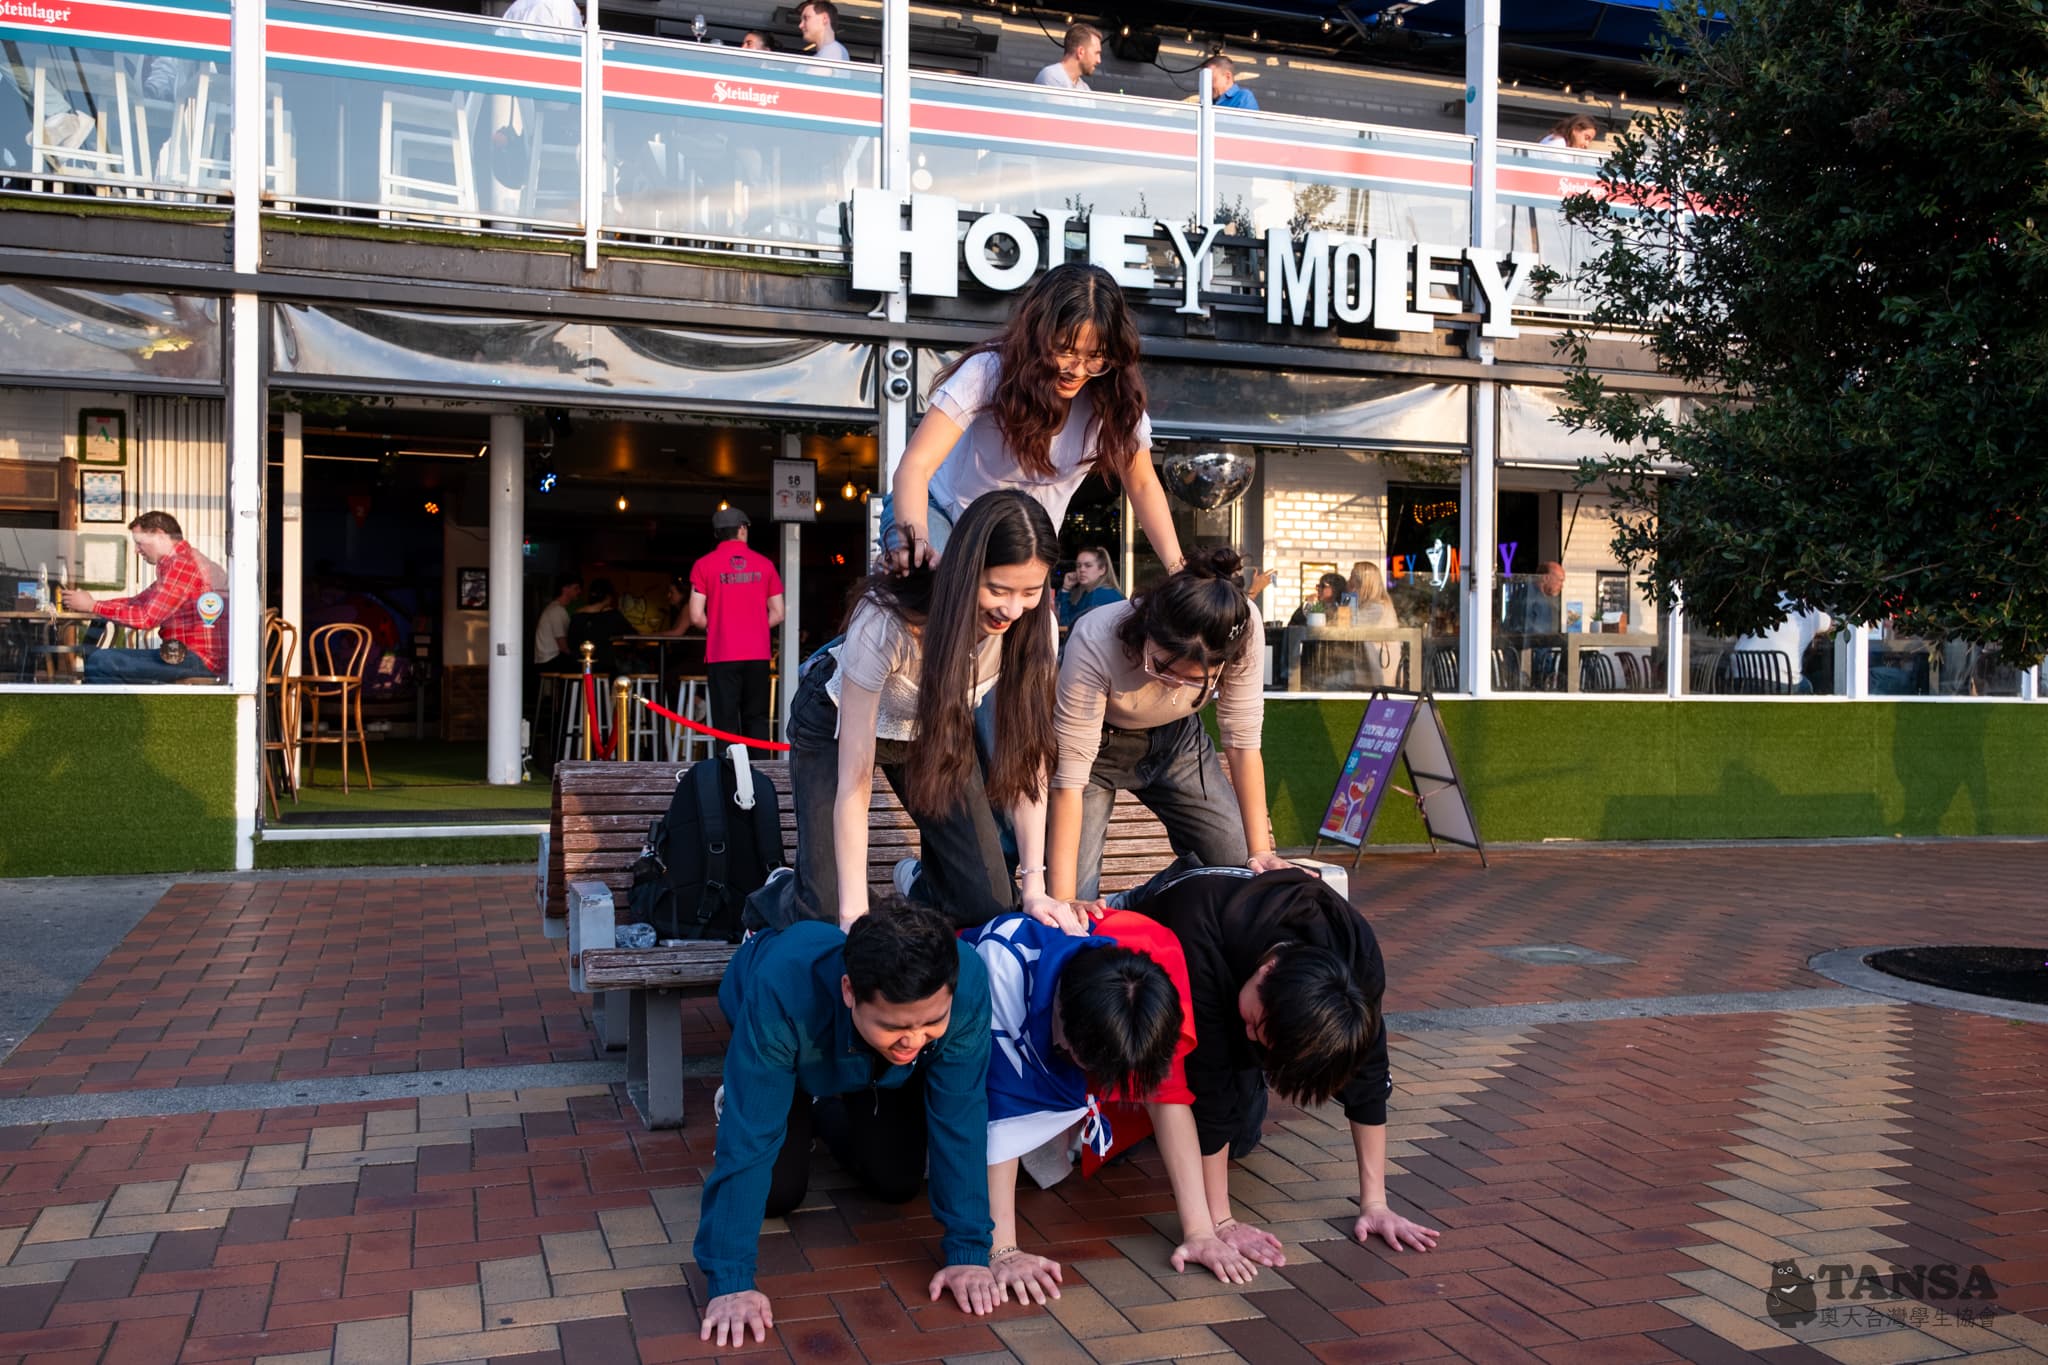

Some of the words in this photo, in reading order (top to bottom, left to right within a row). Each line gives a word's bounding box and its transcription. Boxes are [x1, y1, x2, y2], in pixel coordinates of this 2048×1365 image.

[0, 1, 71, 24] teinlager
[712, 80, 779, 106] Steinlager
[1266, 228, 1540, 338] MOLEY
